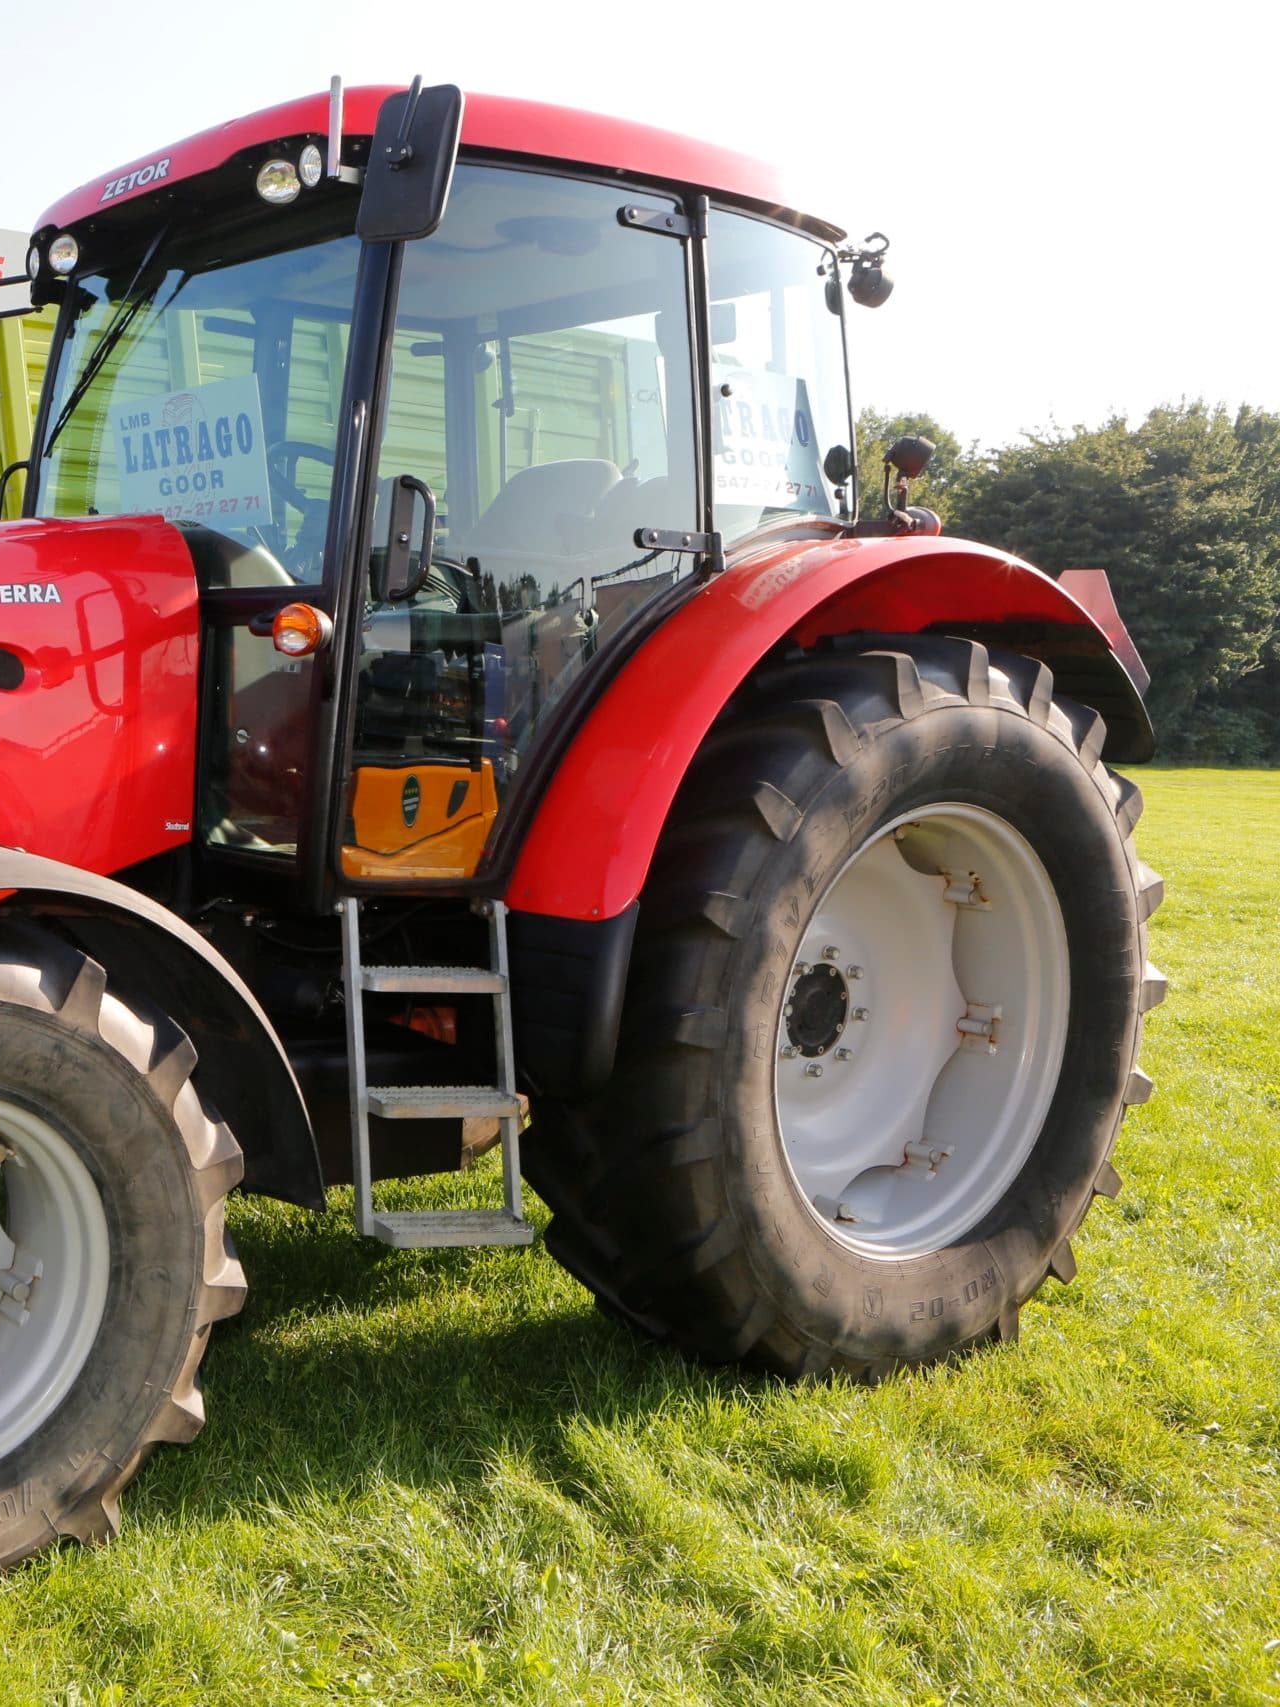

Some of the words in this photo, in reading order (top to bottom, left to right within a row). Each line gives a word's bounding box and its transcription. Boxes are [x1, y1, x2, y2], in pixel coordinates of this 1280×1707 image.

[100, 158, 169, 203] ZETOR
[120, 412, 150, 431] LMB
[122, 412, 253, 474] LATRAGO
[159, 469, 224, 496] GOOR
[785, 482, 801, 496] 27
[220, 498, 239, 512] 27
[244, 496, 260, 509] 71
